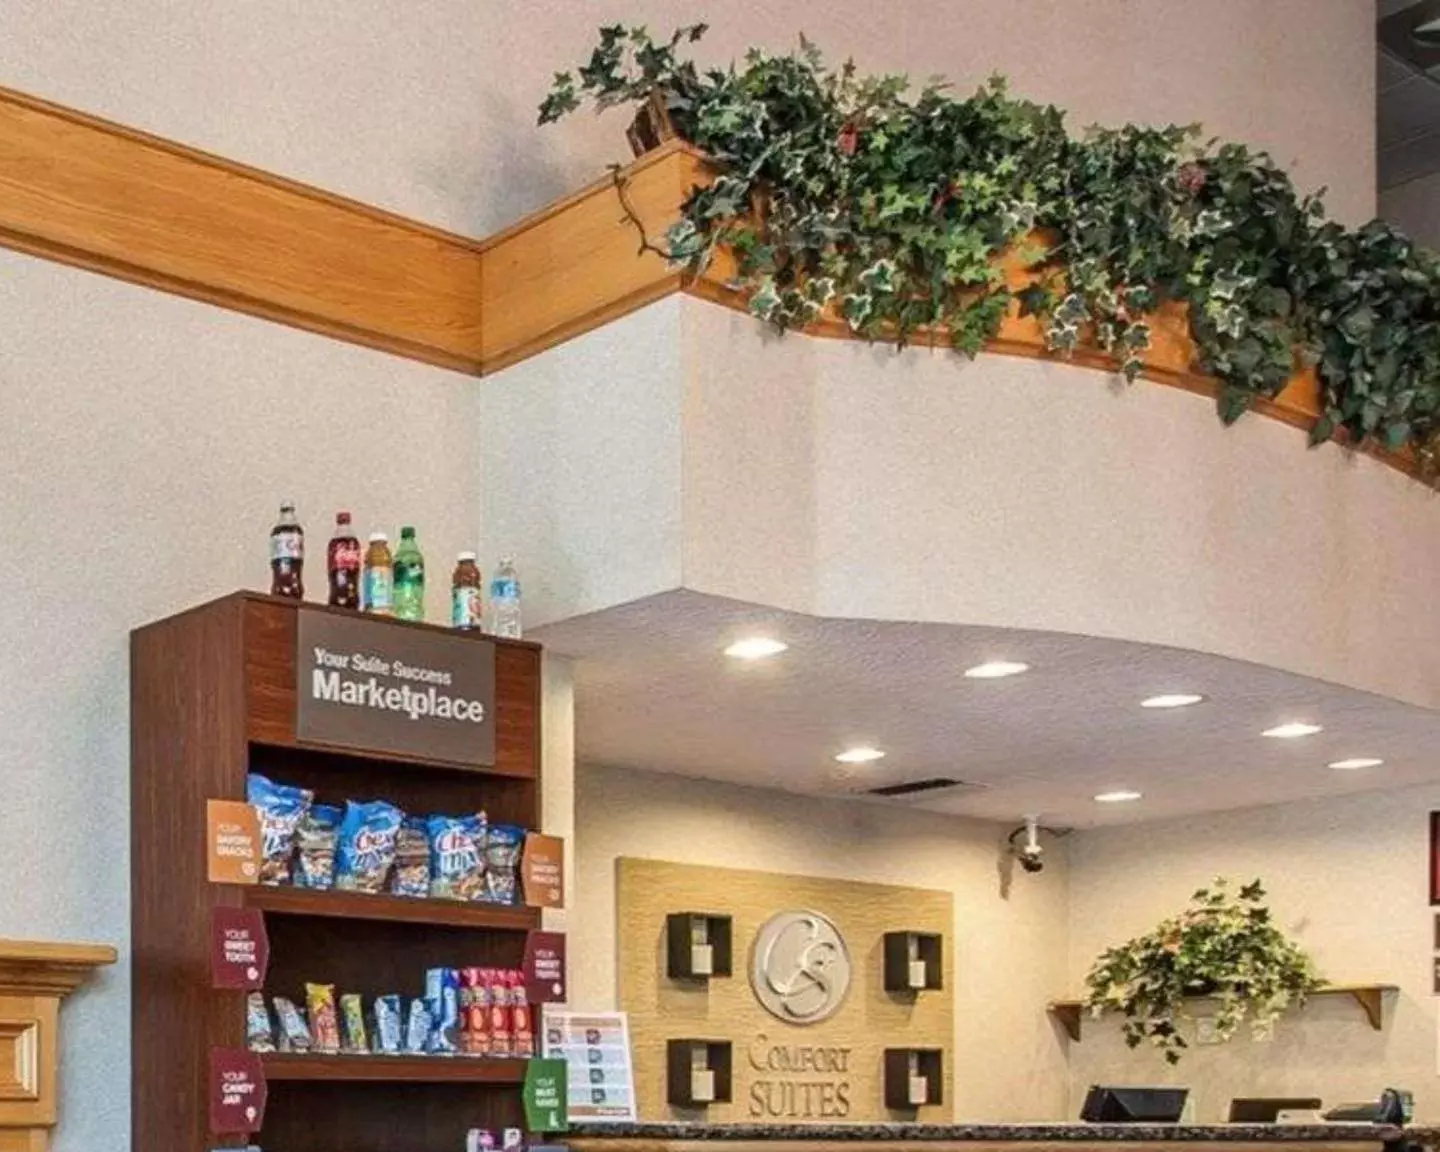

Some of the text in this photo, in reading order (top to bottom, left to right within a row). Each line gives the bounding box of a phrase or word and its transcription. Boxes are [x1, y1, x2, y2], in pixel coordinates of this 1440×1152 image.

[314, 647, 452, 686] Your Suite Success
[312, 668, 485, 723] Marketplace
[224, 928, 249, 940] YOUR
[221, 1082, 256, 1095] CANDY
[222, 1071, 248, 1082] YOUR
[748, 1080, 851, 1117] SUITES
